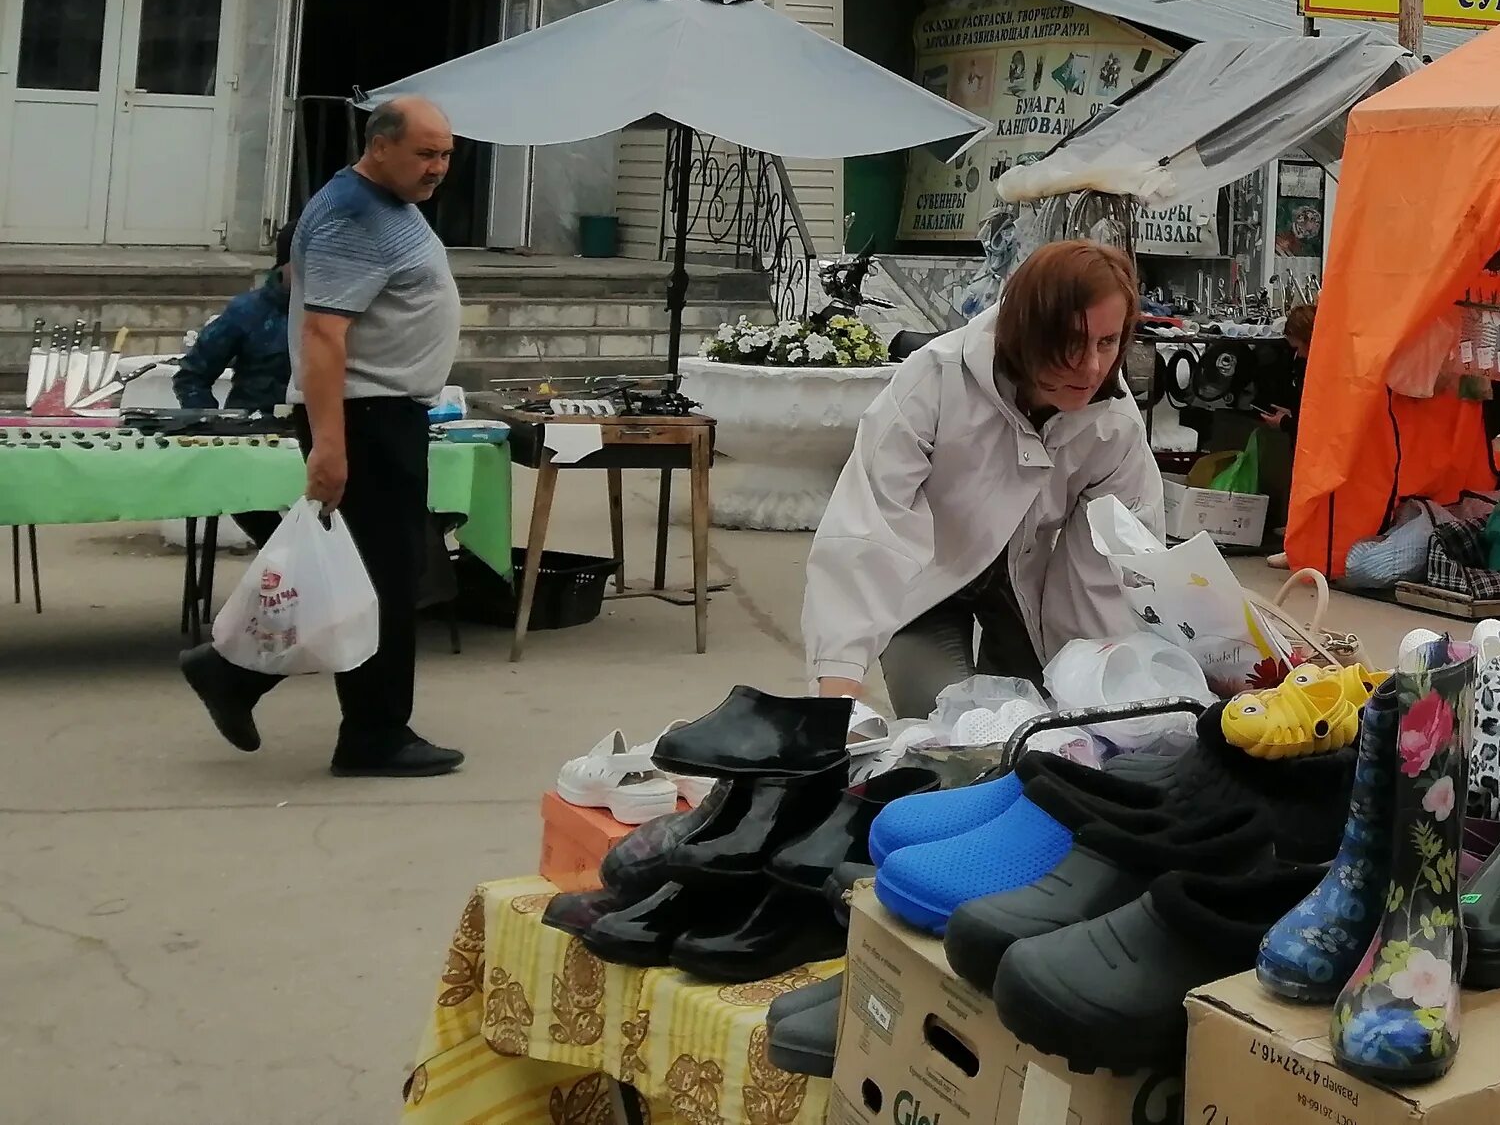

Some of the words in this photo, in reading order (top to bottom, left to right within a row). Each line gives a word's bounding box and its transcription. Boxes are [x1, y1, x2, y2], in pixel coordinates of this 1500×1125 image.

[962, 25, 1030, 47] РАЗВИВАЮЩАЯ
[1015, 96, 1066, 115] БУМАГА
[916, 192, 967, 210] СУВЕНИРЫ
[913, 210, 964, 230] НАКЛЕЙКИ
[1322, 1075, 1360, 1108] Размер
